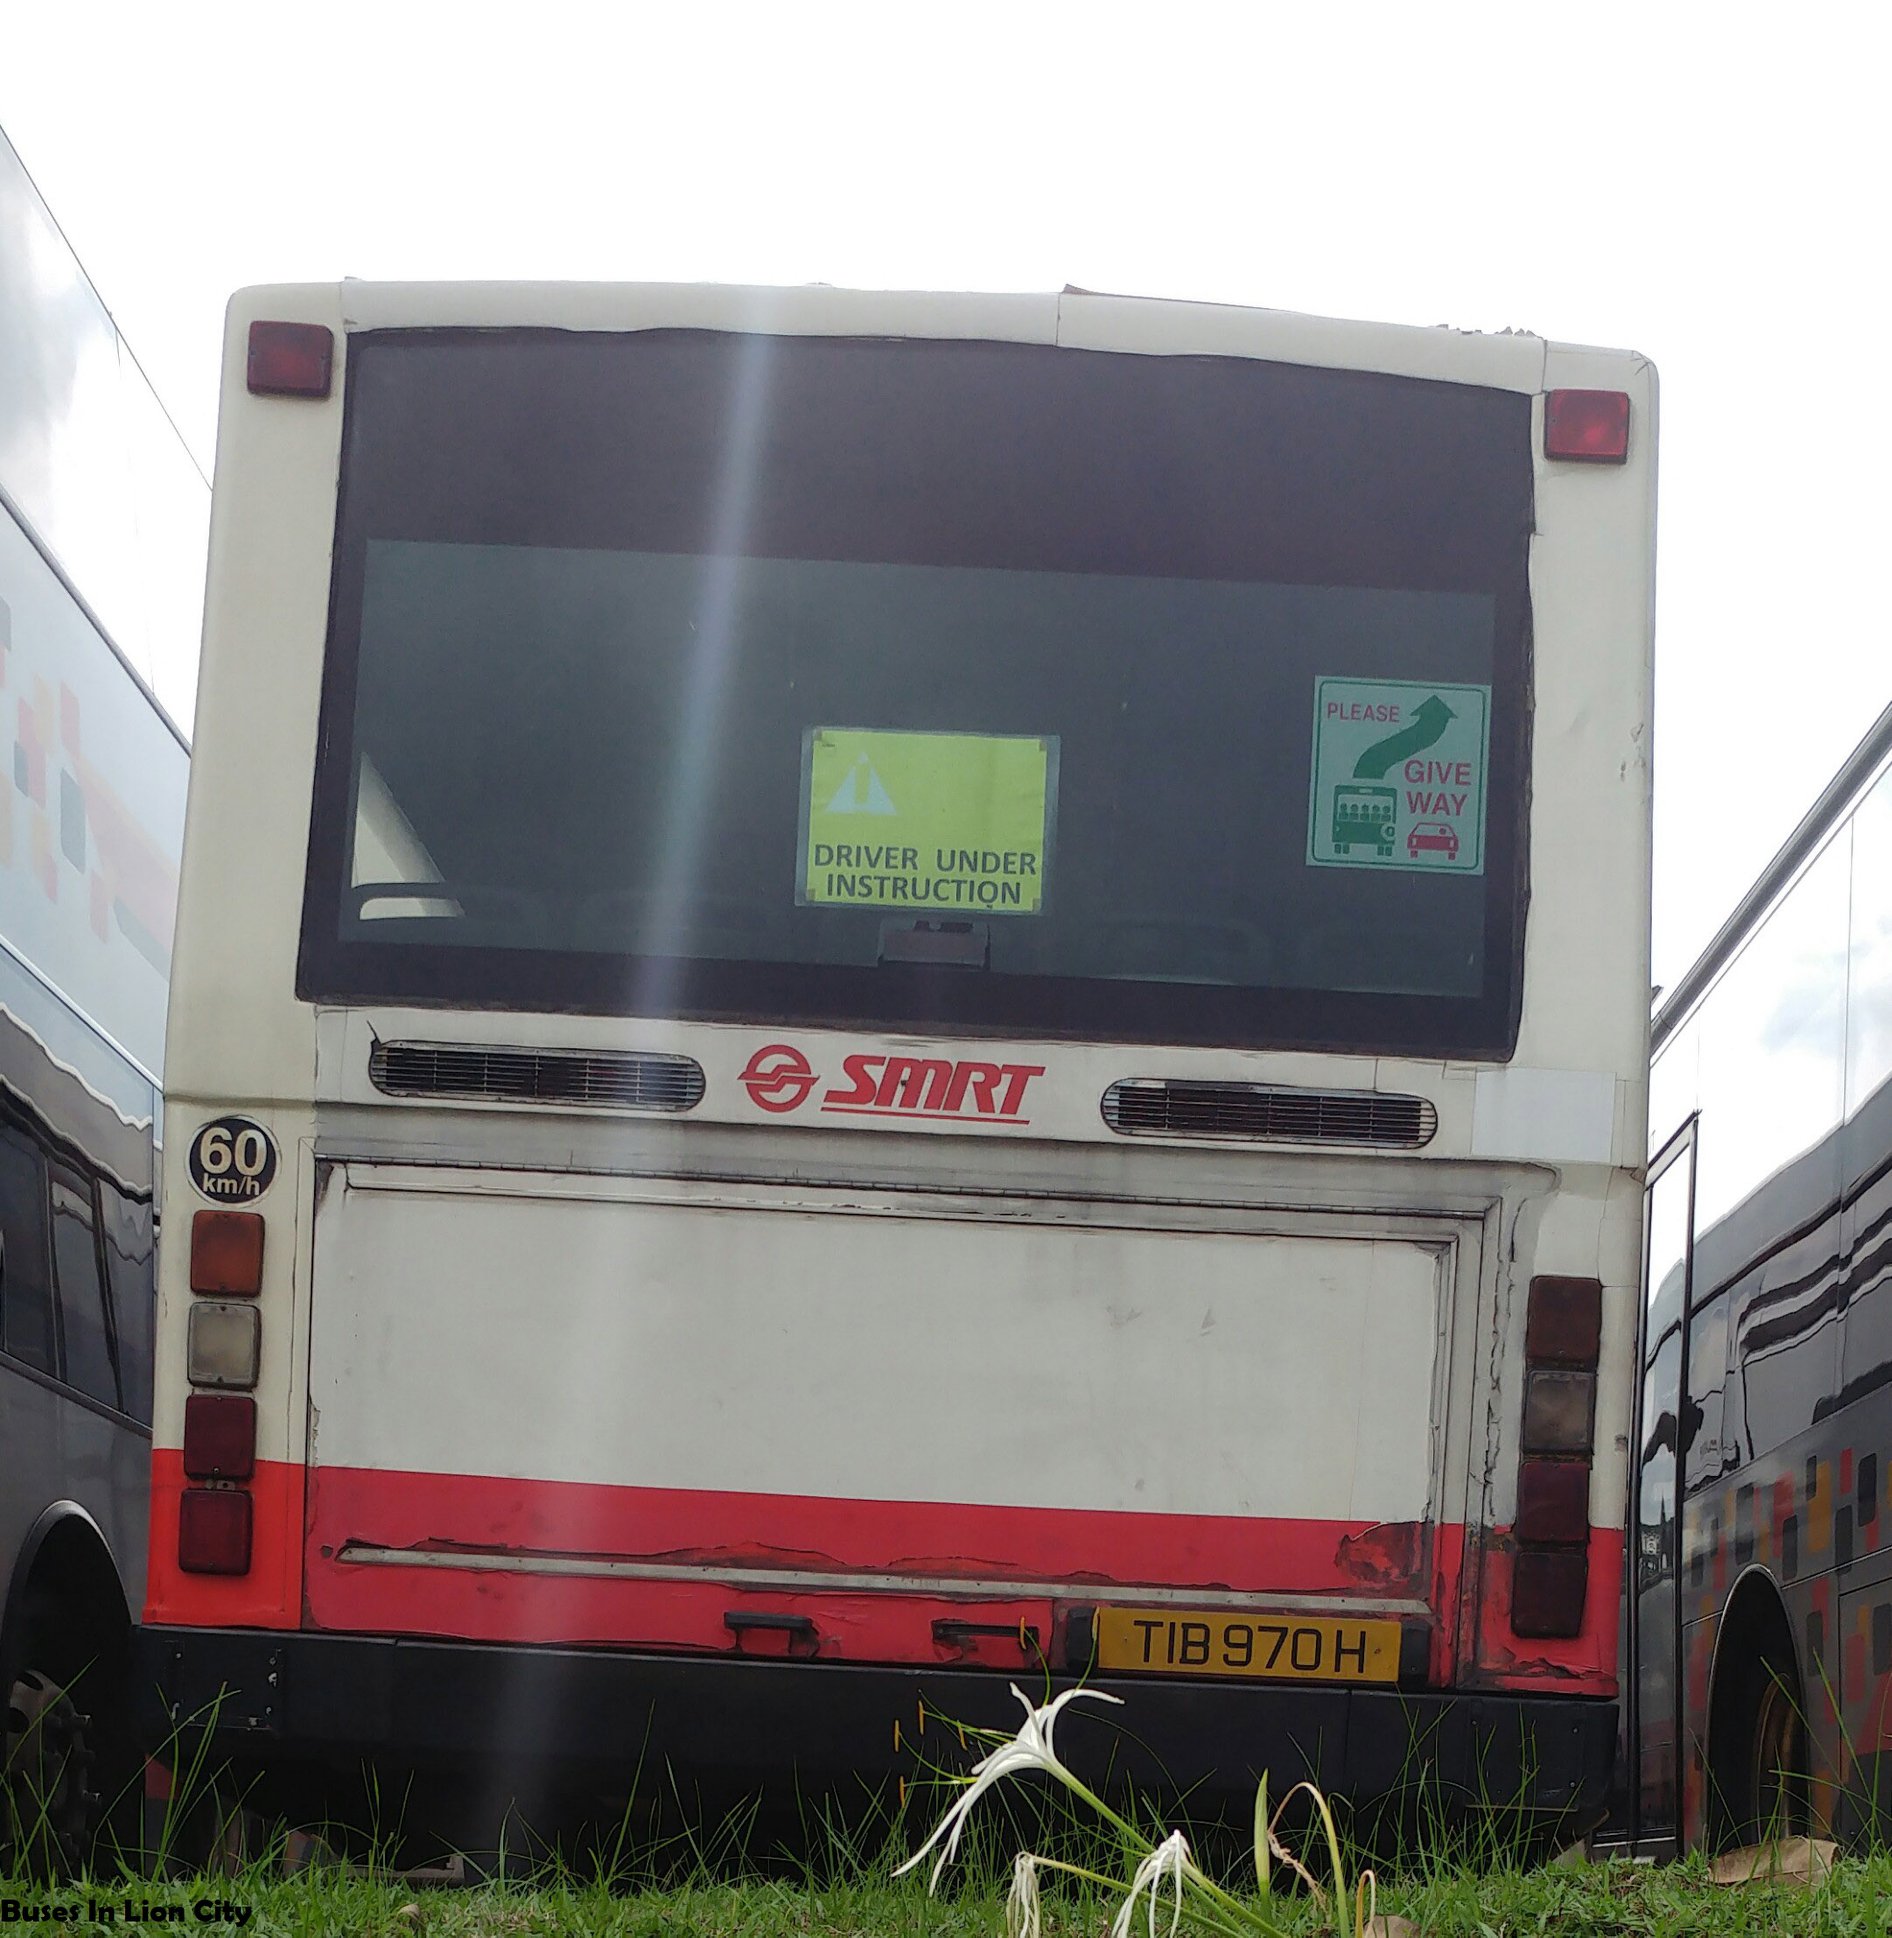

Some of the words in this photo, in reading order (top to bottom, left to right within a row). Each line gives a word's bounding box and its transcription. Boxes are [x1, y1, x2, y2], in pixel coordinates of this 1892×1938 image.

[1327, 702, 1400, 722] PLEASE
[1404, 759, 1472, 786] GIVE
[1406, 791, 1467, 816] WAY
[814, 844, 918, 870] DRIVER
[936, 849, 1036, 875] UNDER
[827, 874, 1021, 904] INSTRUCTION
[823, 1054, 1046, 1114] SMRT
[200, 1127, 267, 1176] 60
[203, 1173, 260, 1195] km/h
